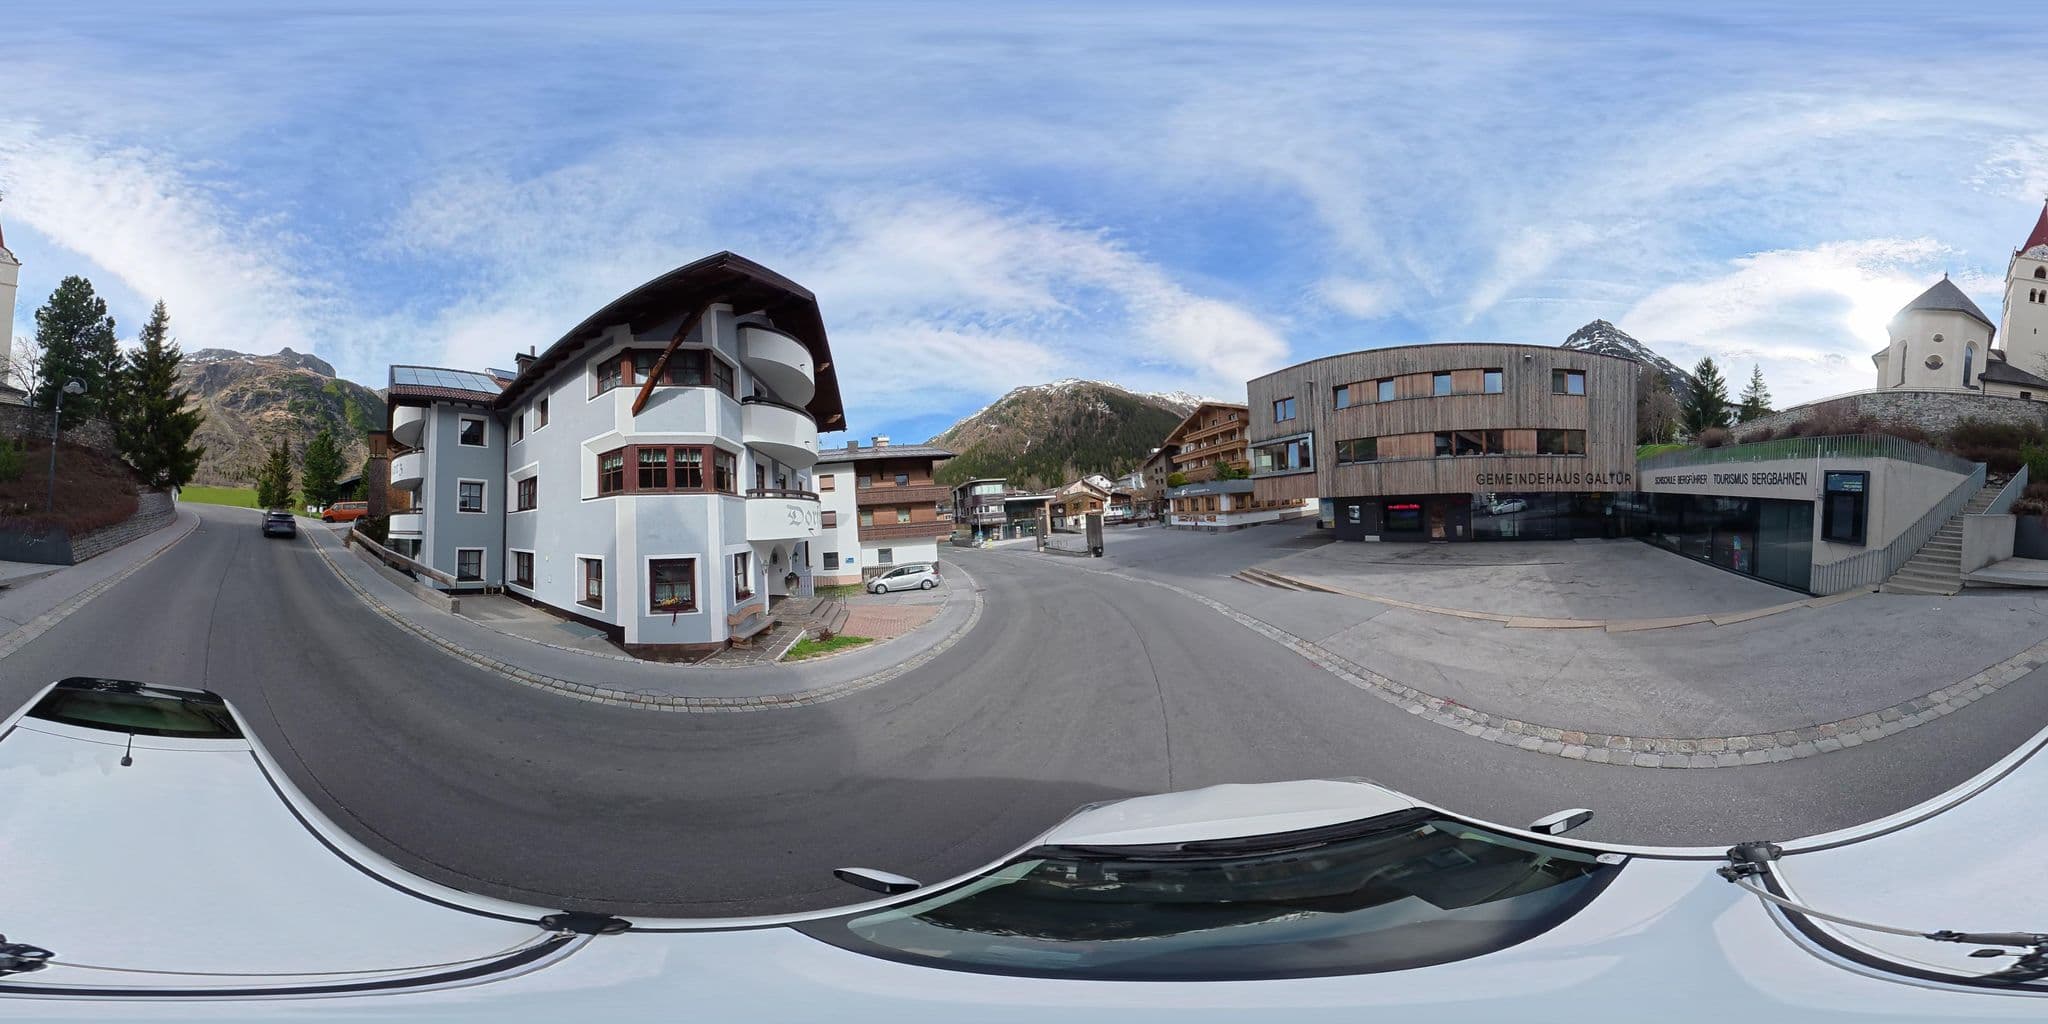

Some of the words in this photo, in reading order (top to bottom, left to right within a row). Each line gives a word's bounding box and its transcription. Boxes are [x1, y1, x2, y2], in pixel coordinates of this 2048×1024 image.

[1476, 472, 1581, 486] GEMEINDEHAUS
[1585, 471, 1632, 485] GALTÜR
[1677, 472, 1708, 485] BERGFÜHRER
[1713, 472, 1749, 485] TOURISMUS
[1751, 471, 1808, 486] BERGBAHNEN
